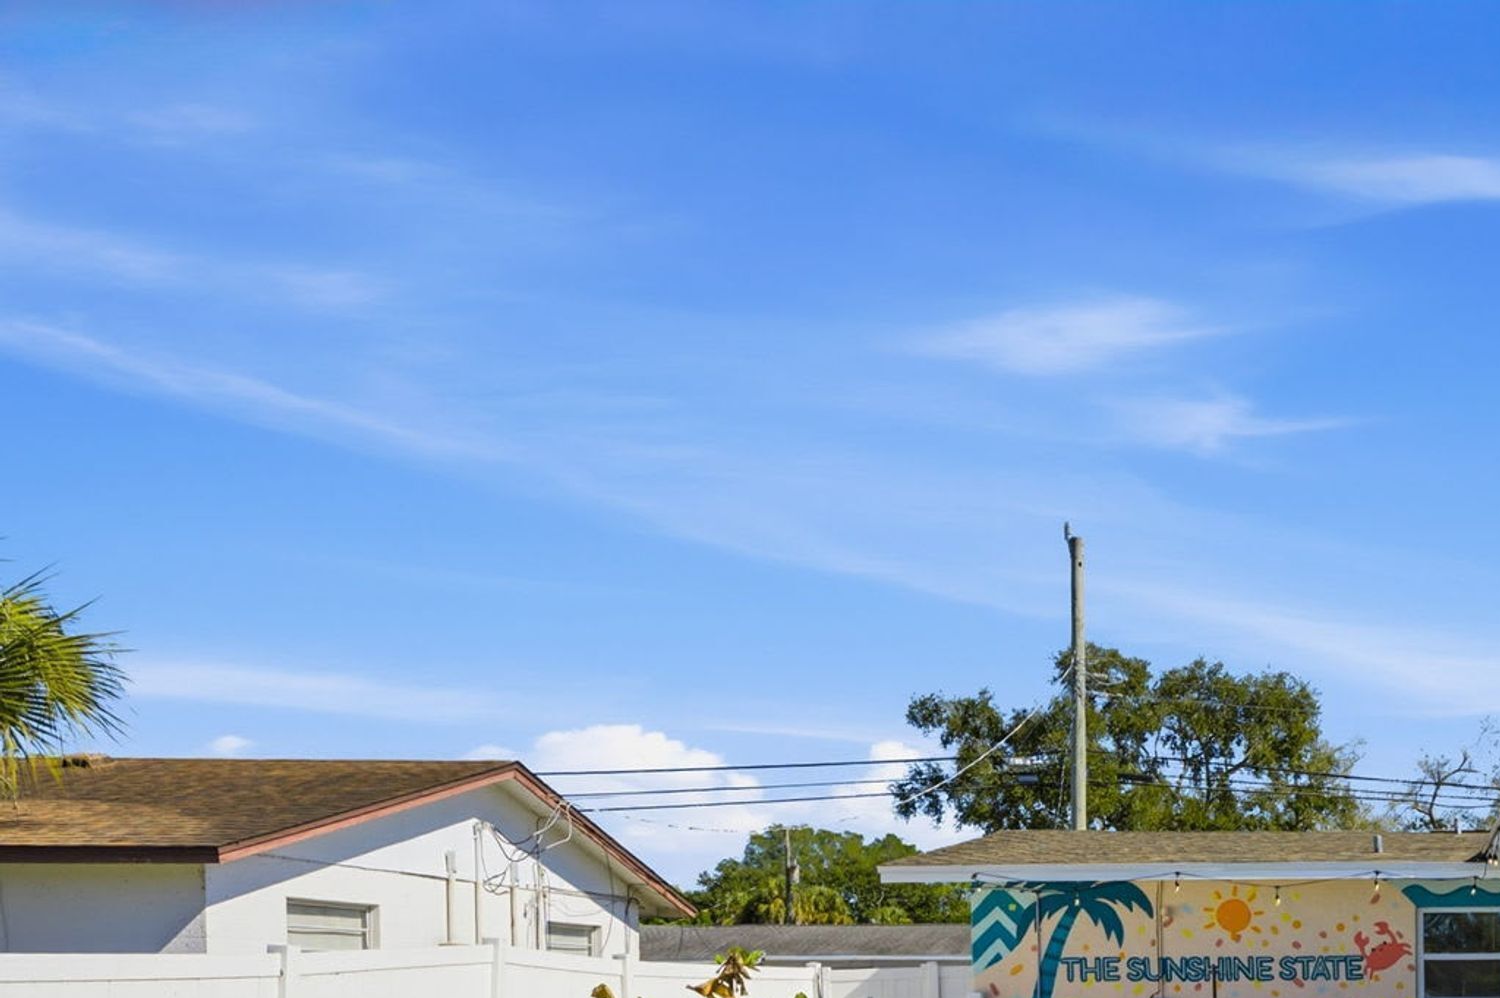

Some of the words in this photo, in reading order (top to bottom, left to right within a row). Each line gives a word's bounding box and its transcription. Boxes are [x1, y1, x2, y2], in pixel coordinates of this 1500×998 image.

[1061, 956, 1121, 983] THE
[1127, 956, 1275, 982] SUNSHINE
[1279, 955, 1365, 981] STATE
